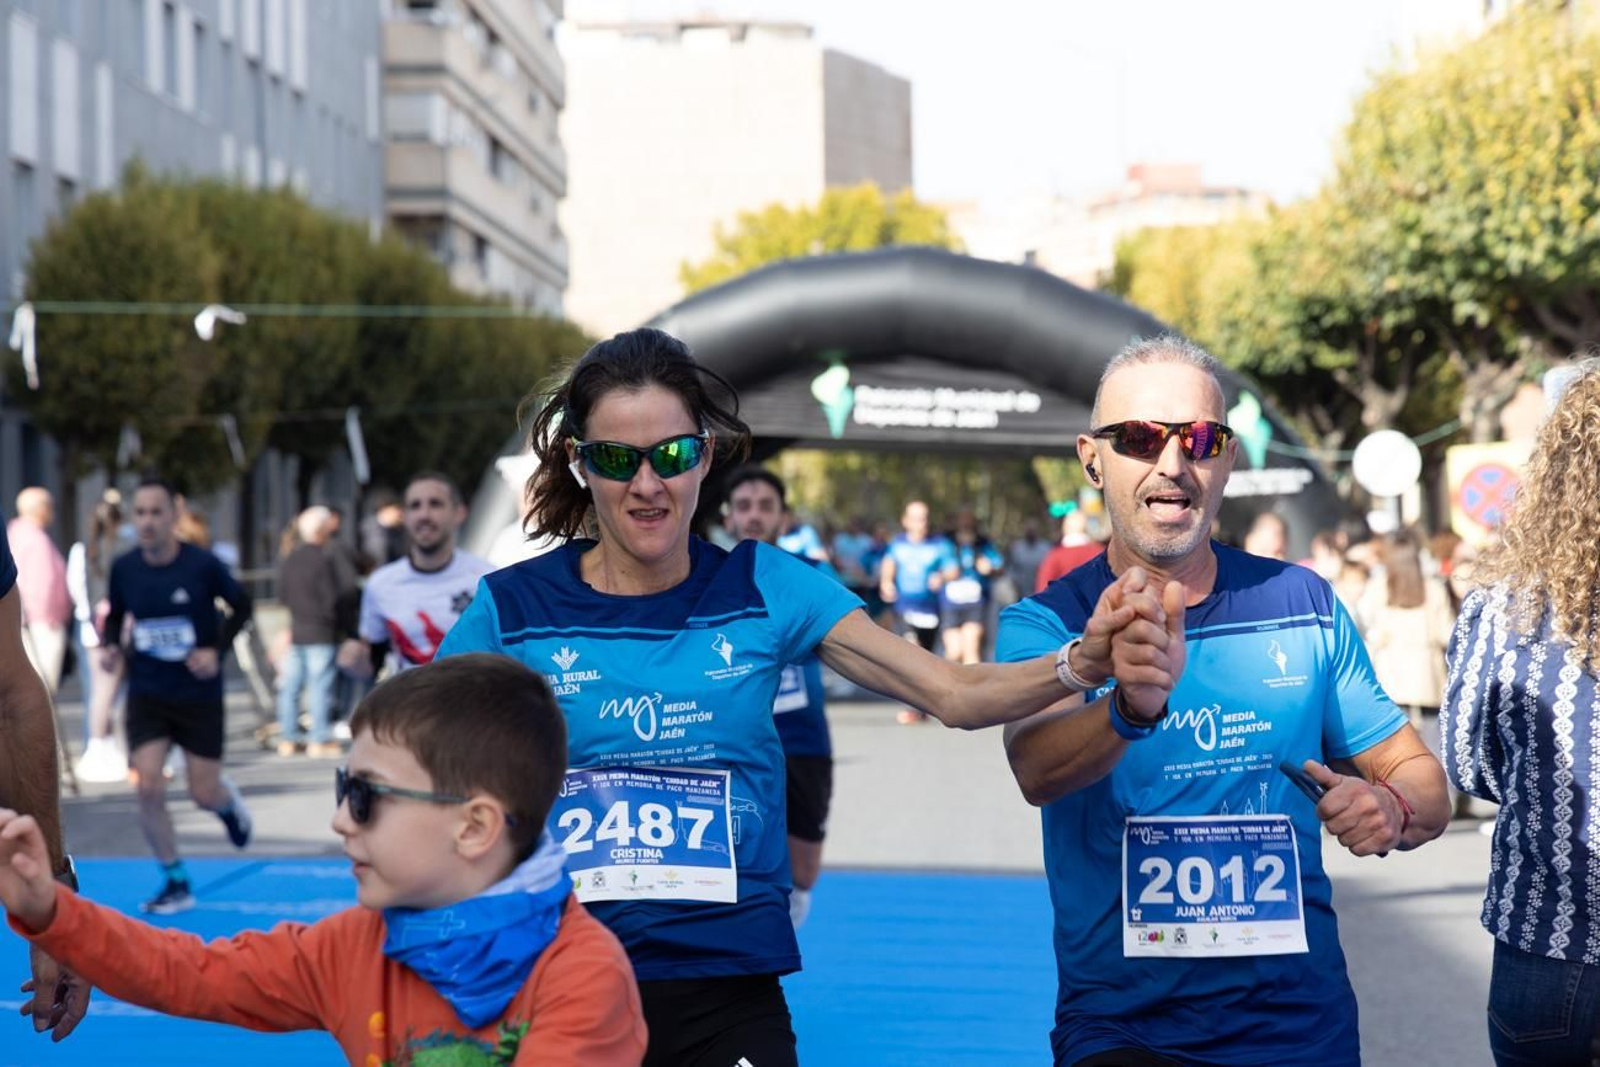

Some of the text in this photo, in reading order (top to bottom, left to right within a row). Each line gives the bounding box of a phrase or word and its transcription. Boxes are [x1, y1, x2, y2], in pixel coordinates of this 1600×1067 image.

[562, 669, 601, 683] RURAL
[553, 683, 580, 696] JAÉN
[663, 701, 697, 713] MEDIA
[661, 711, 713, 726] MARATÓN
[1222, 711, 1256, 723] MEDIA
[659, 728, 686, 740] JAÉN
[1221, 721, 1271, 736] MARATÓN
[1219, 737, 1245, 749] JAÉN
[609, 773, 629, 781] MEDIA
[630, 773, 662, 783] MARATÓN
[690, 778, 699, 786] DE
[626, 781, 653, 789] MEMORIA
[666, 784, 682, 792] PACO
[558, 800, 714, 855] 2487
[1189, 827, 1210, 835] MEDIA
[1211, 826, 1239, 834] MARATÓN
[610, 848, 664, 859] CRISTINA
[1138, 854, 1287, 905] 2012
[1175, 905, 1255, 917] JUAN ANTONIO
